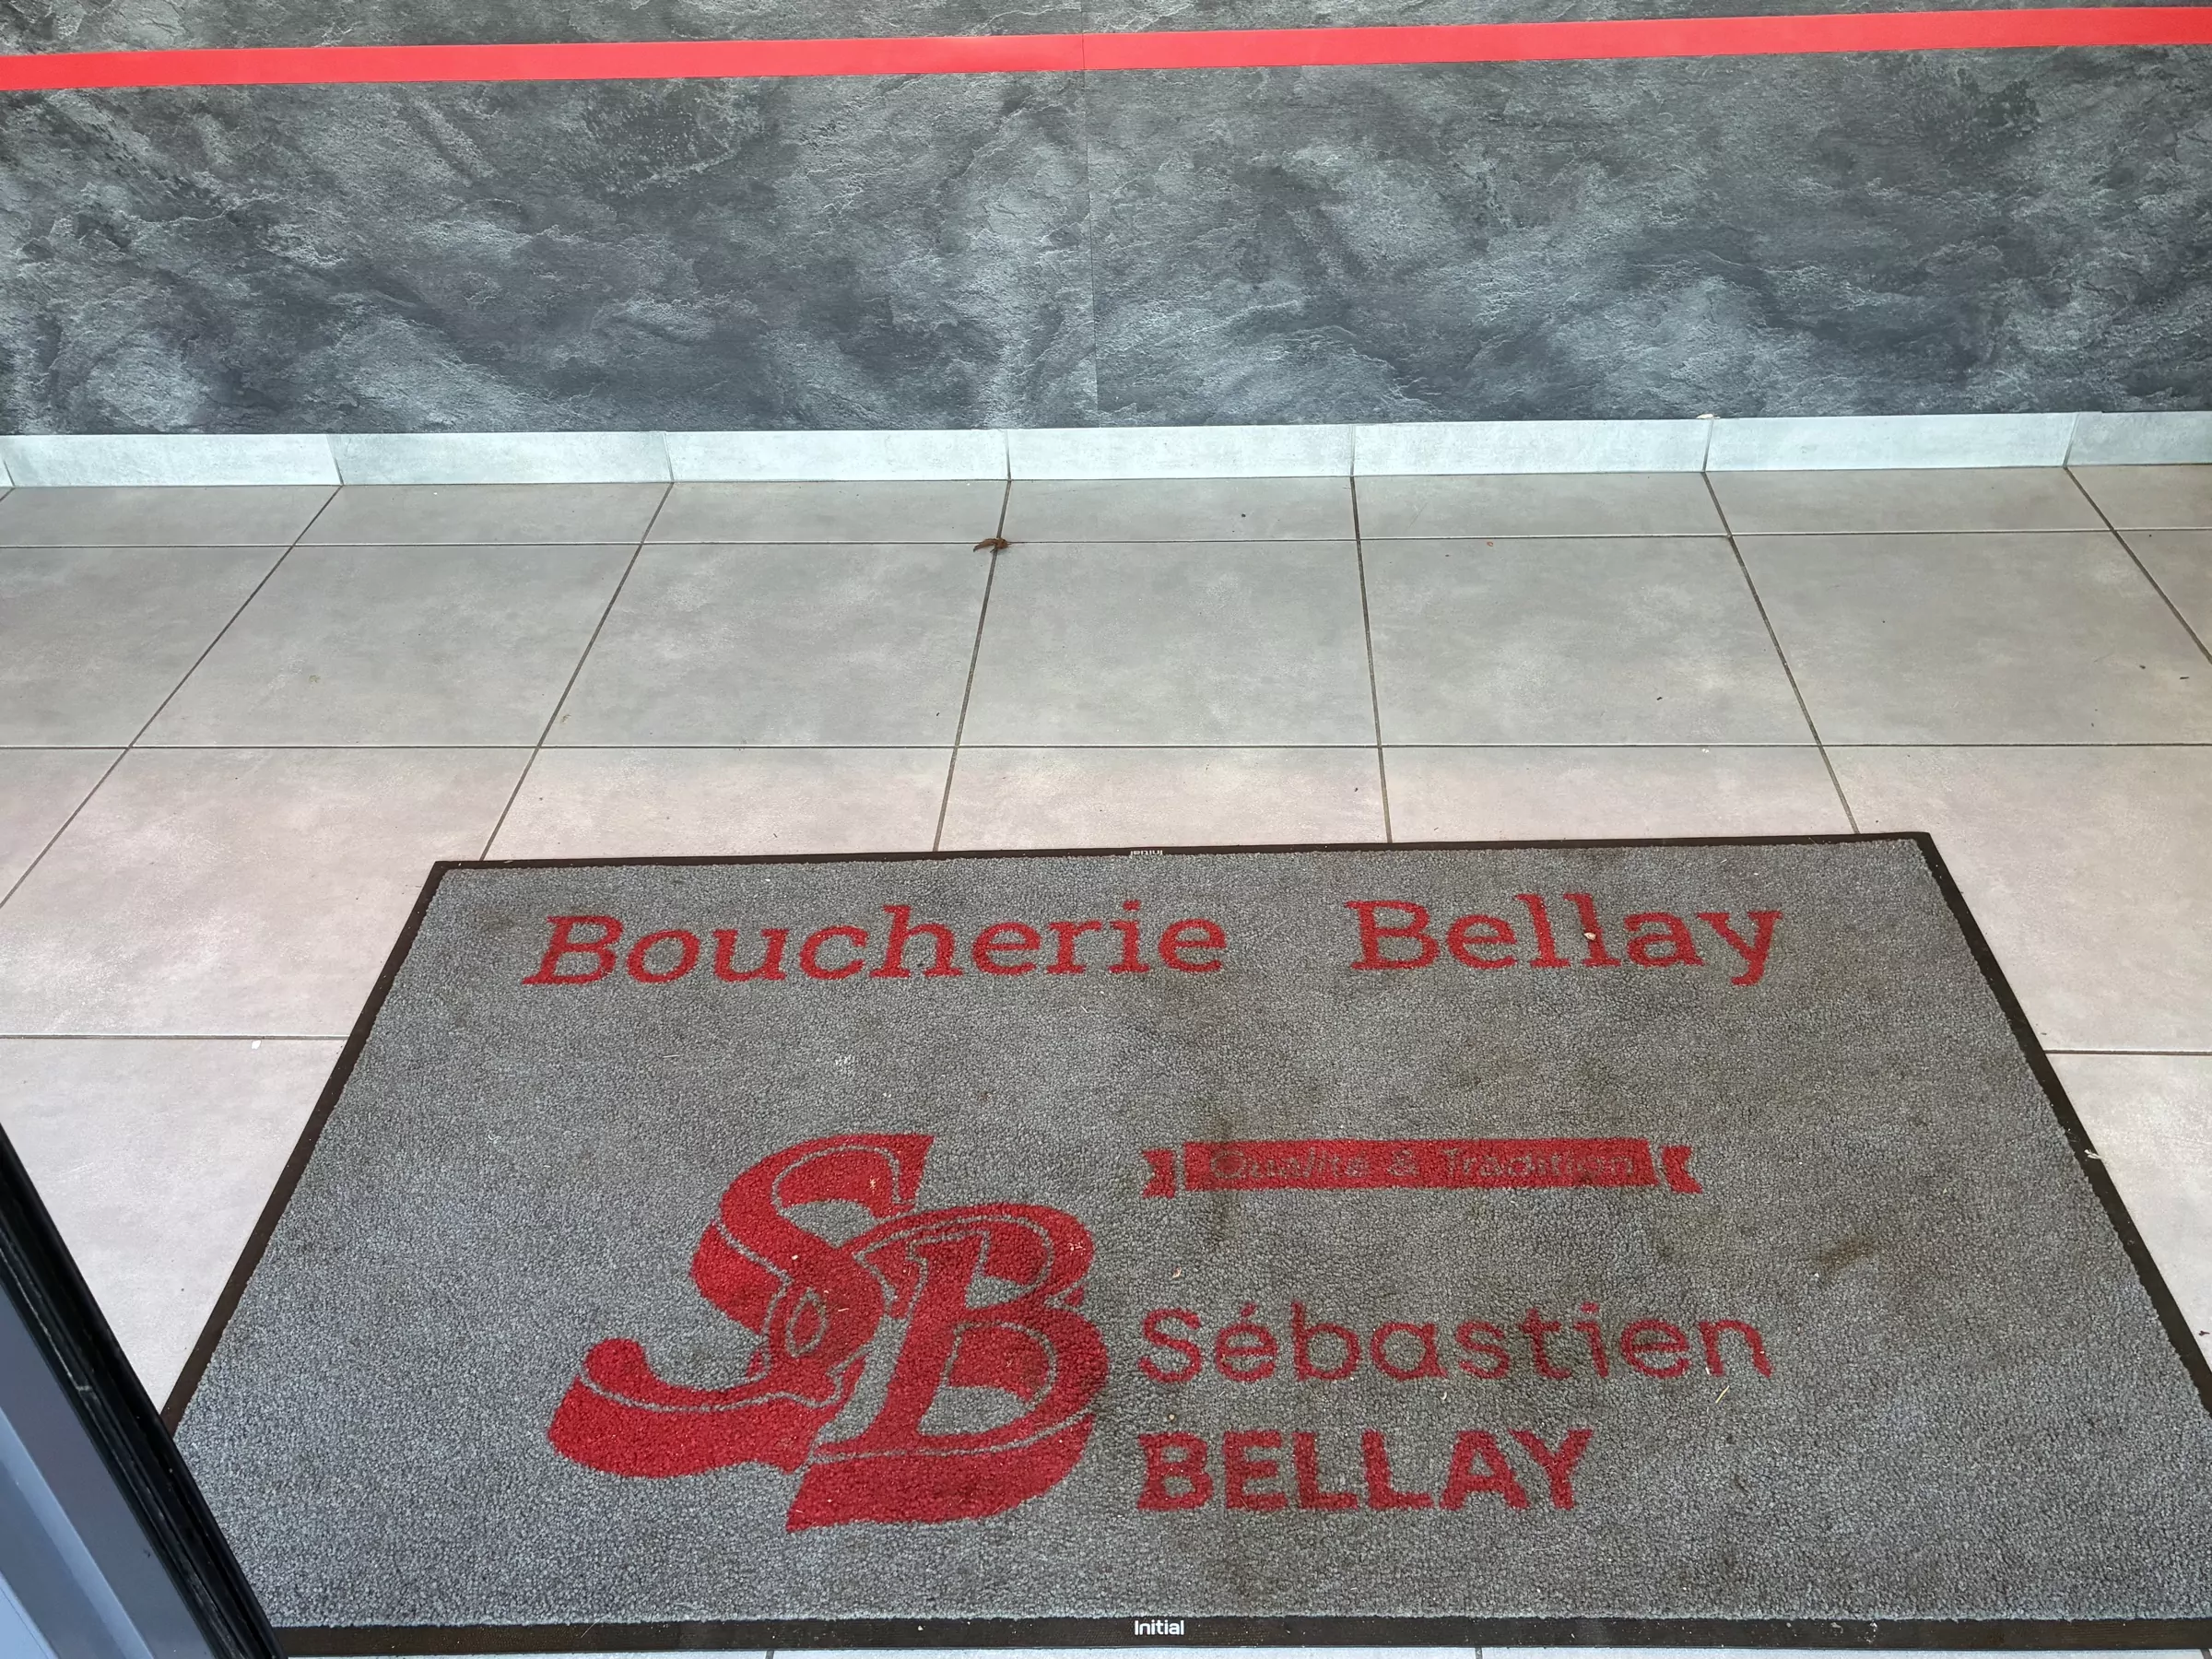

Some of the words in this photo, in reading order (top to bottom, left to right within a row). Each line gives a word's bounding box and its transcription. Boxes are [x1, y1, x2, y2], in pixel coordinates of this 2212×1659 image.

[523, 900, 1227, 985] Boucherie
[1345, 892, 1783, 986] Bellay
[1386, 1149, 1419, 1177] &
[1138, 1301, 1773, 1383] Sébastien
[1137, 1429, 1593, 1512] BELLAY
[1134, 1619, 1184, 1636] Initial
